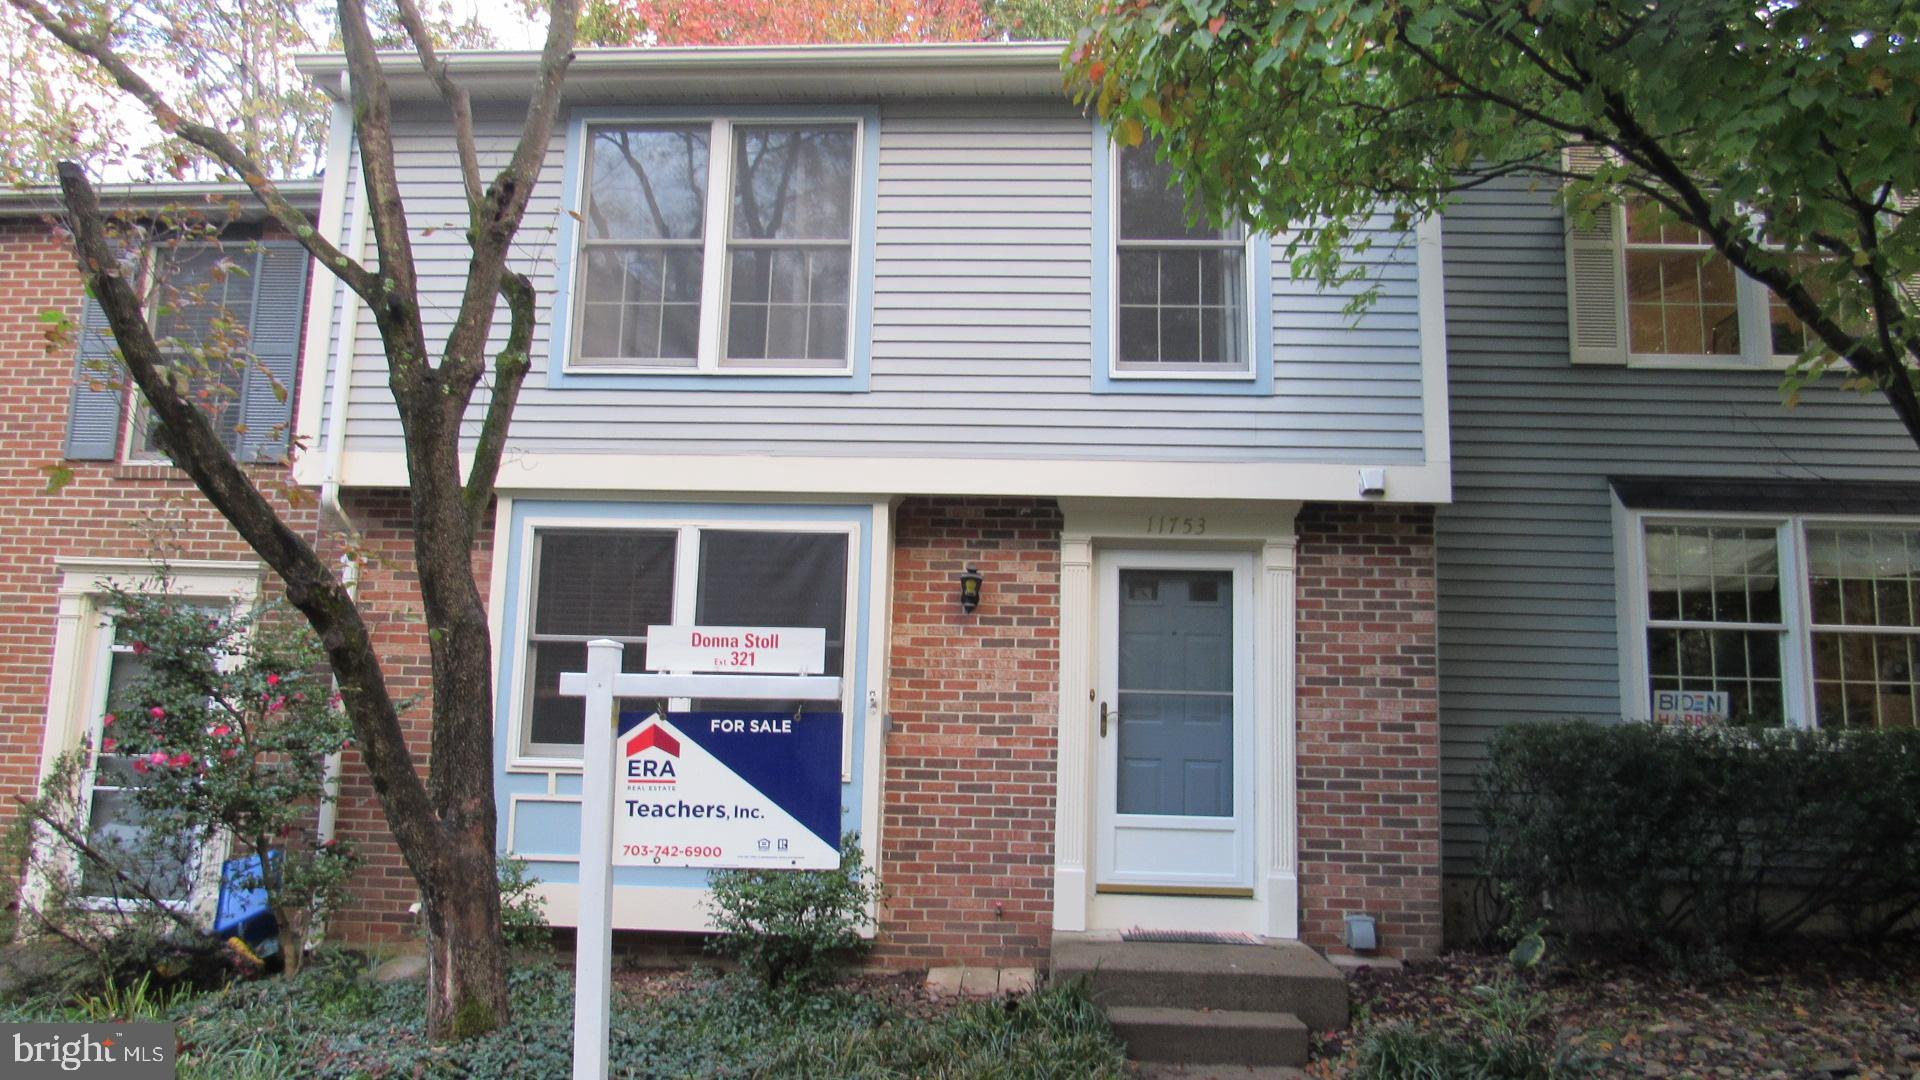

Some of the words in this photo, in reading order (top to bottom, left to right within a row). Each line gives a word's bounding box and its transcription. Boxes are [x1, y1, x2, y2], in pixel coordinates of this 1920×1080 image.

[1146, 516, 1207, 534] 11753
[691, 632, 739, 648] Donna
[744, 633, 779, 649] Stoll
[730, 651, 755, 666] 321
[1659, 694, 1721, 712] BIDEN
[711, 719, 745, 733] FOR
[750, 720, 792, 733] SALE
[627, 760, 676, 777] ERA
[625, 800, 730, 820] Teachers,
[734, 805, 765, 819] Inc.
[623, 845, 722, 857] 703-742-6900
